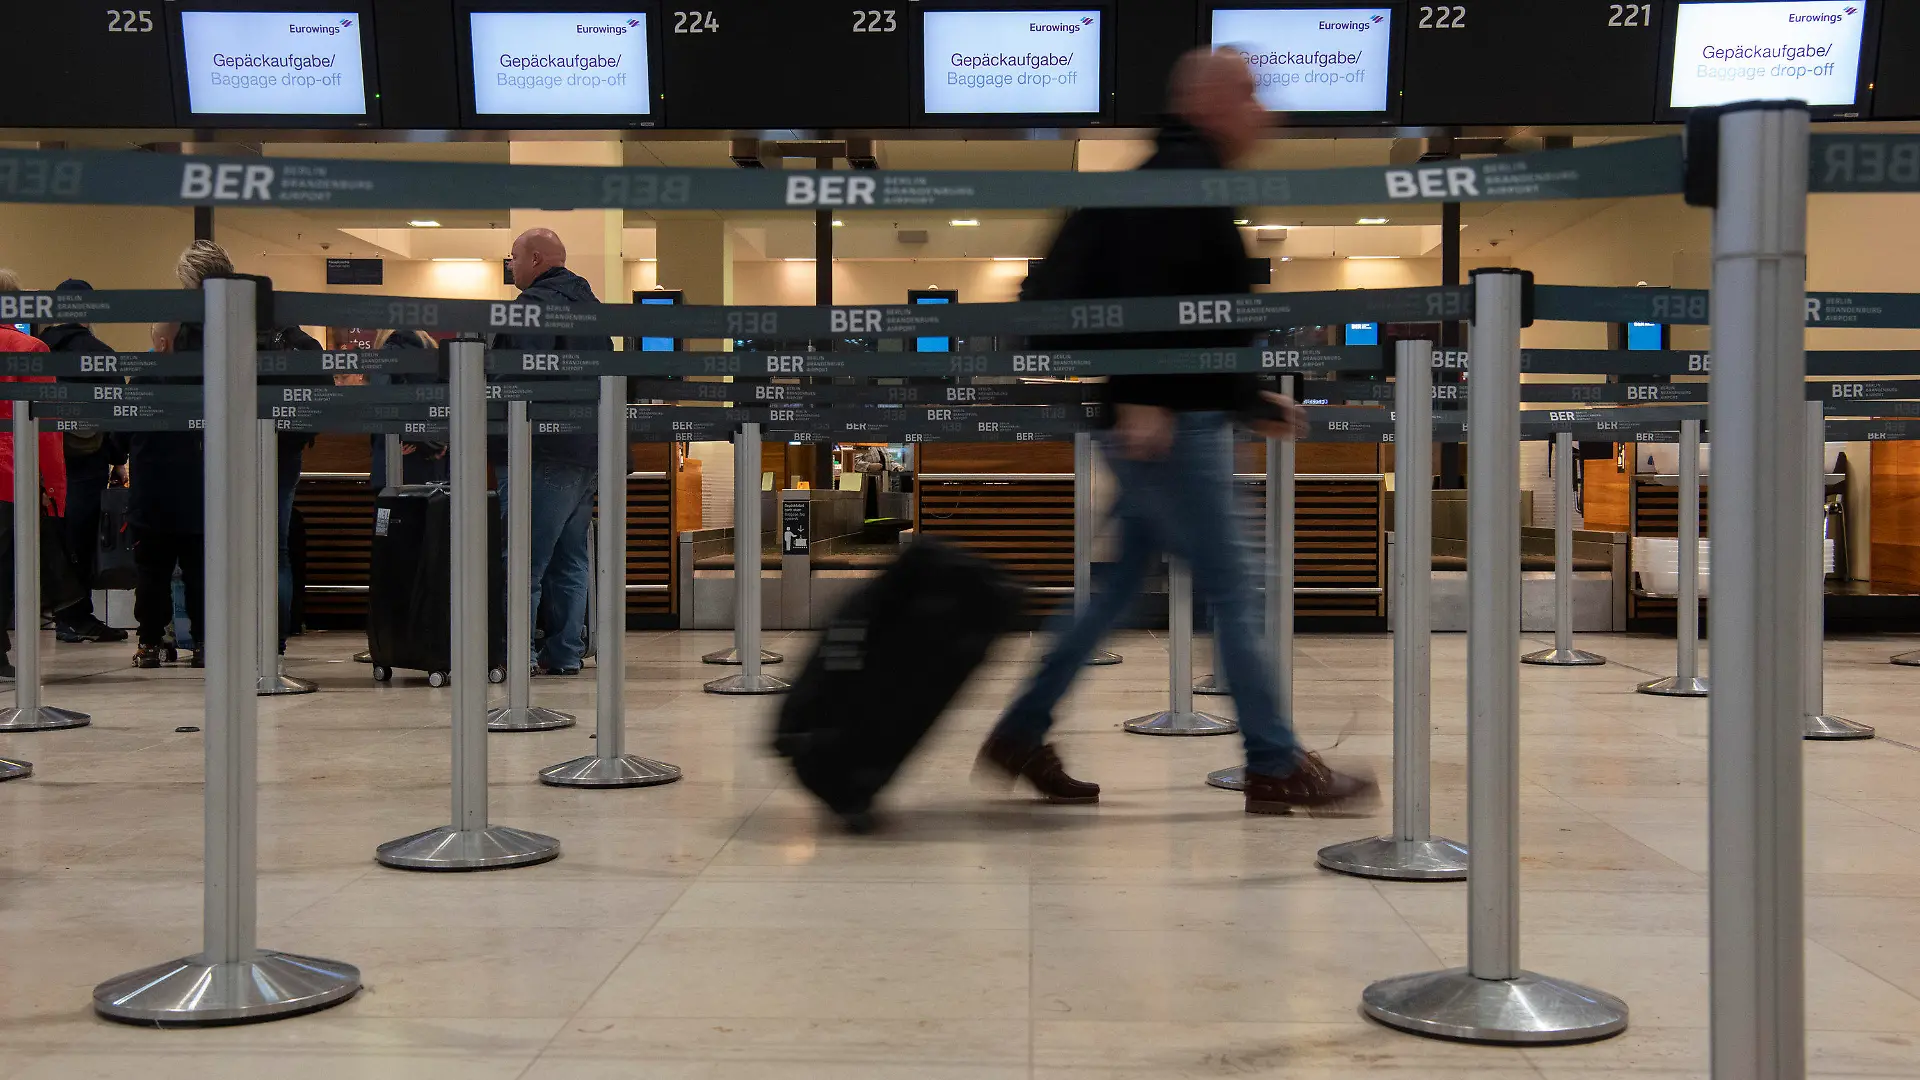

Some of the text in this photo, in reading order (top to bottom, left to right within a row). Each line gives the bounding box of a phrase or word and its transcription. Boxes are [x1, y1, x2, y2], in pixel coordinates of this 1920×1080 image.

[107, 10, 153, 32] 225
[674, 11, 719, 33] 224
[853, 10, 897, 32] 223
[1418, 6, 1466, 28] 222
[1608, 4, 1650, 27] 221
[1788, 12, 1842, 24] Eurowings
[289, 24, 340, 36] Eurowings
[576, 24, 627, 36] Eurowings
[1029, 22, 1080, 33] Eurowings
[1318, 21, 1370, 32] Eurowings
[1702, 43, 1832, 61] Gepäckaufgabe/
[213, 54, 336, 70] Gepäckaufgabe/
[500, 54, 622, 70] Gepäckaufgabe/
[951, 52, 1074, 69] Gepäckaufgabe/
[947, 71, 1078, 88] Baggage drop-off
[1304, 69, 1365, 86] drop-off
[1697, 62, 1835, 81] Baggage drop-off
[211, 72, 342, 89] Baggage drop-off
[497, 72, 627, 89] Baggage drop-off
[181, 163, 273, 200] BER
[1385, 167, 1479, 198] BER
[786, 176, 875, 205] BER
[0, 295, 53, 319] BER
[490, 303, 541, 327] BER
[1179, 300, 1232, 324] BER
[831, 309, 882, 333] BER
[81, 355, 117, 372] BER
[322, 353, 358, 370] BER
[523, 354, 559, 371] BER
[767, 355, 803, 372] BER
[1013, 355, 1050, 372] BER
[1262, 351, 1299, 368] BER
[1431, 351, 1468, 368] BER
[1689, 354, 1712, 371] BE
[94, 386, 122, 400] BER
[283, 388, 311, 401] BER
[486, 386, 502, 399] ER
[756, 386, 784, 400] BER
[947, 387, 976, 401] BER
[1628, 386, 1658, 400] BER
[1832, 383, 1863, 398] BER
[114, 405, 138, 417] BER
[273, 406, 297, 417] BER
[770, 409, 794, 421] BER
[928, 409, 952, 421] BER
[1550, 411, 1575, 421] BER
[57, 421, 78, 431] BER
[277, 420, 290, 429] ER
[405, 423, 426, 433] BER
[540, 423, 560, 433] BER
[979, 422, 999, 432] BER
[1329, 421, 1349, 431] BER
[676, 433, 693, 441] BER
[794, 433, 812, 441] BER
[906, 434, 923, 442] BER
[1017, 433, 1034, 441] BER
[1637, 433, 1654, 441] BER
